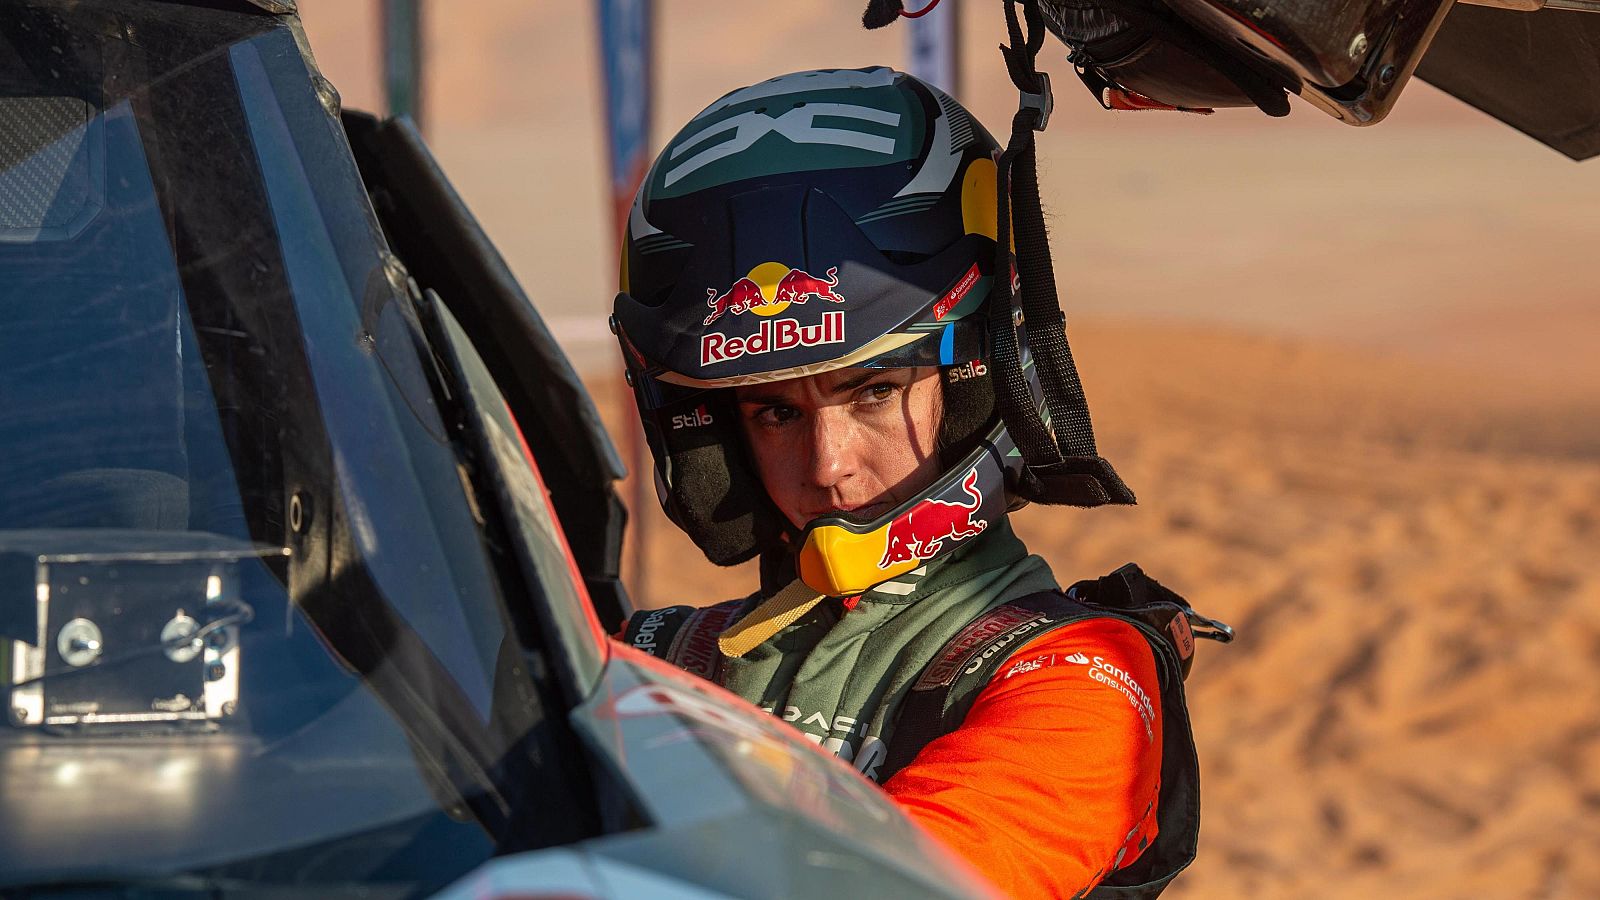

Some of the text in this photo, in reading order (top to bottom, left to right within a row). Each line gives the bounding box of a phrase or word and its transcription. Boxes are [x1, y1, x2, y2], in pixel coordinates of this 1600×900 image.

[700, 319, 771, 367] Red
[773, 310, 846, 351] Bull
[949, 360, 988, 384] stilo
[672, 405, 714, 430] stilo
[1088, 667, 1140, 708] Consumer
[1093, 656, 1156, 721] Santander
